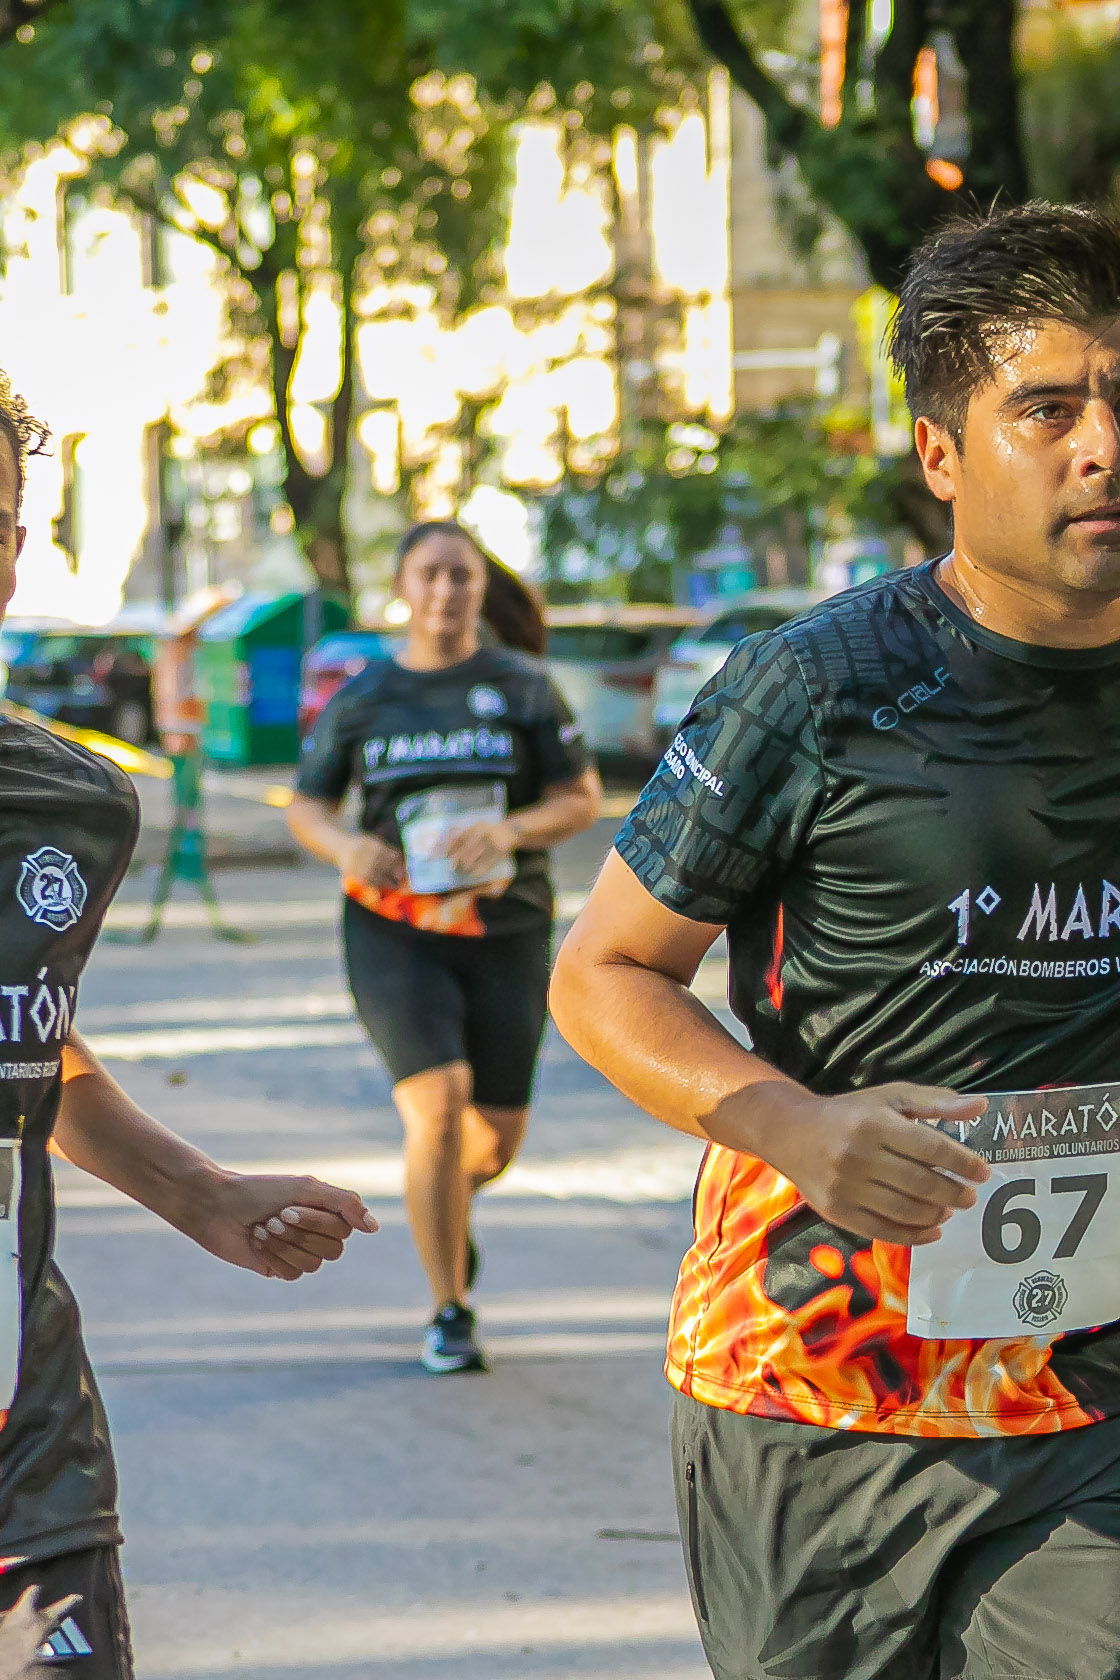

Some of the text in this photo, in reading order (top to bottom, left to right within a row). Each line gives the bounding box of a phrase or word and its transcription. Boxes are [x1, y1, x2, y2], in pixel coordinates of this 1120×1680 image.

[920, 956, 1016, 977] ASOCIACIÓN
[1018, 957, 1110, 978] BOMBEROS
[995, 1148, 1050, 1161] BOMBEROS
[1053, 1138, 1120, 1156] VOLUNTARIOS
[981, 1172, 1108, 1265] 67
[1031, 1288, 1053, 1308] 27
